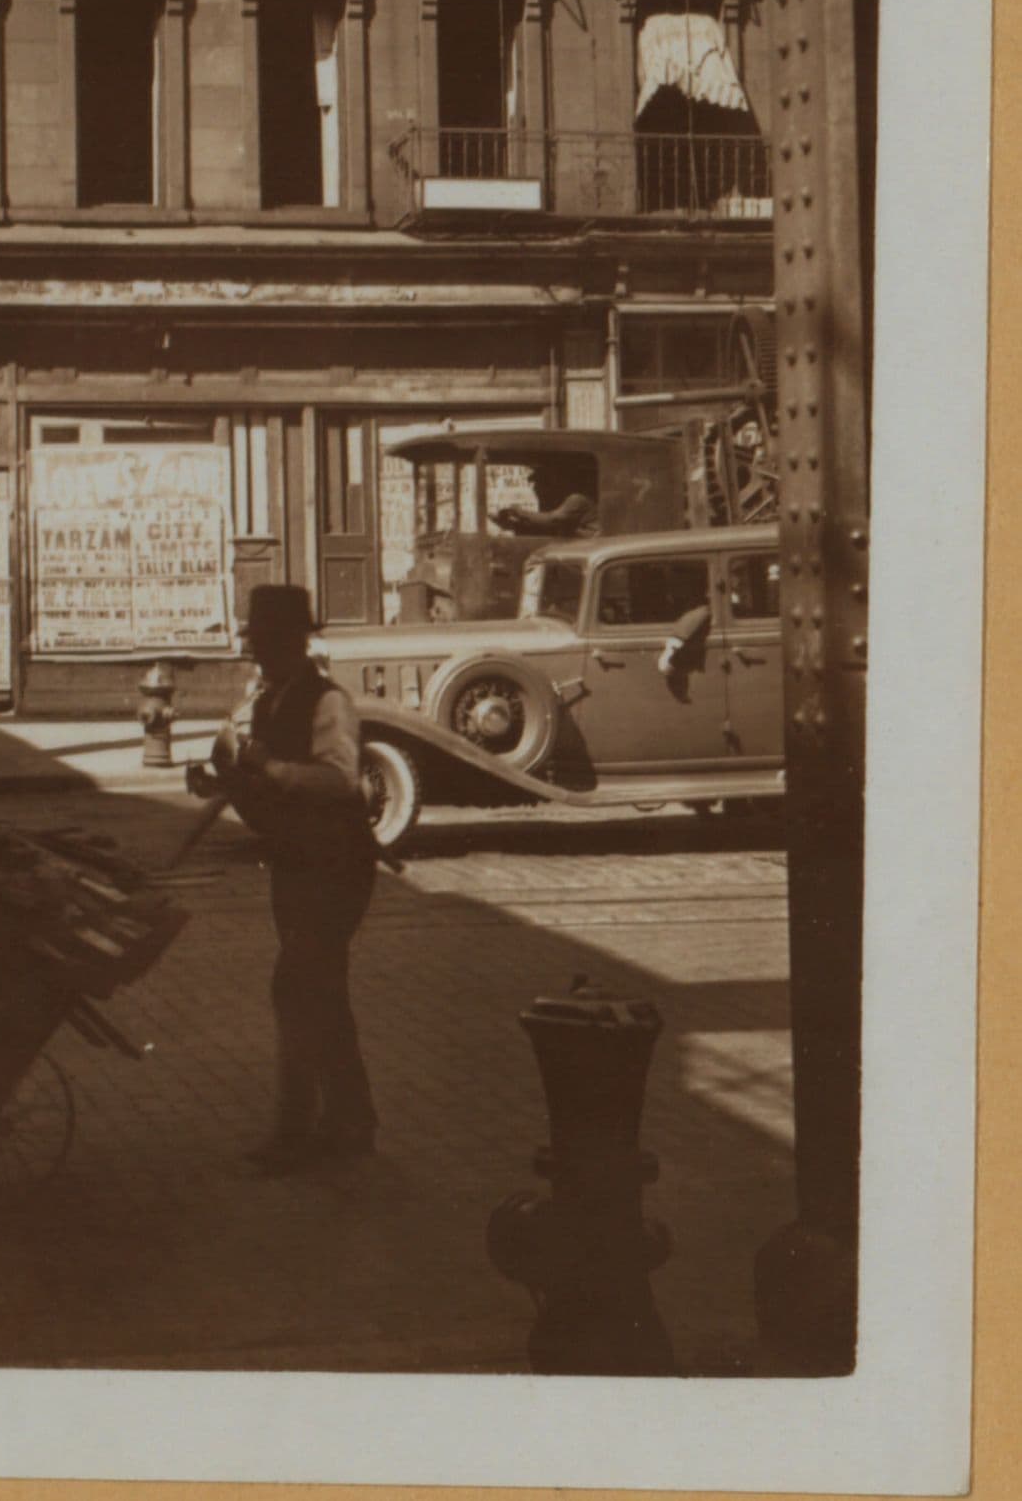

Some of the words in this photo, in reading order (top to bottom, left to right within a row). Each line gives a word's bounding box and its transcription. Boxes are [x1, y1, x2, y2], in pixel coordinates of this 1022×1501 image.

[42, 529, 132, 550] TARZAN
[147, 522, 204, 540] CITY
[138, 562, 174, 576] SALLY
